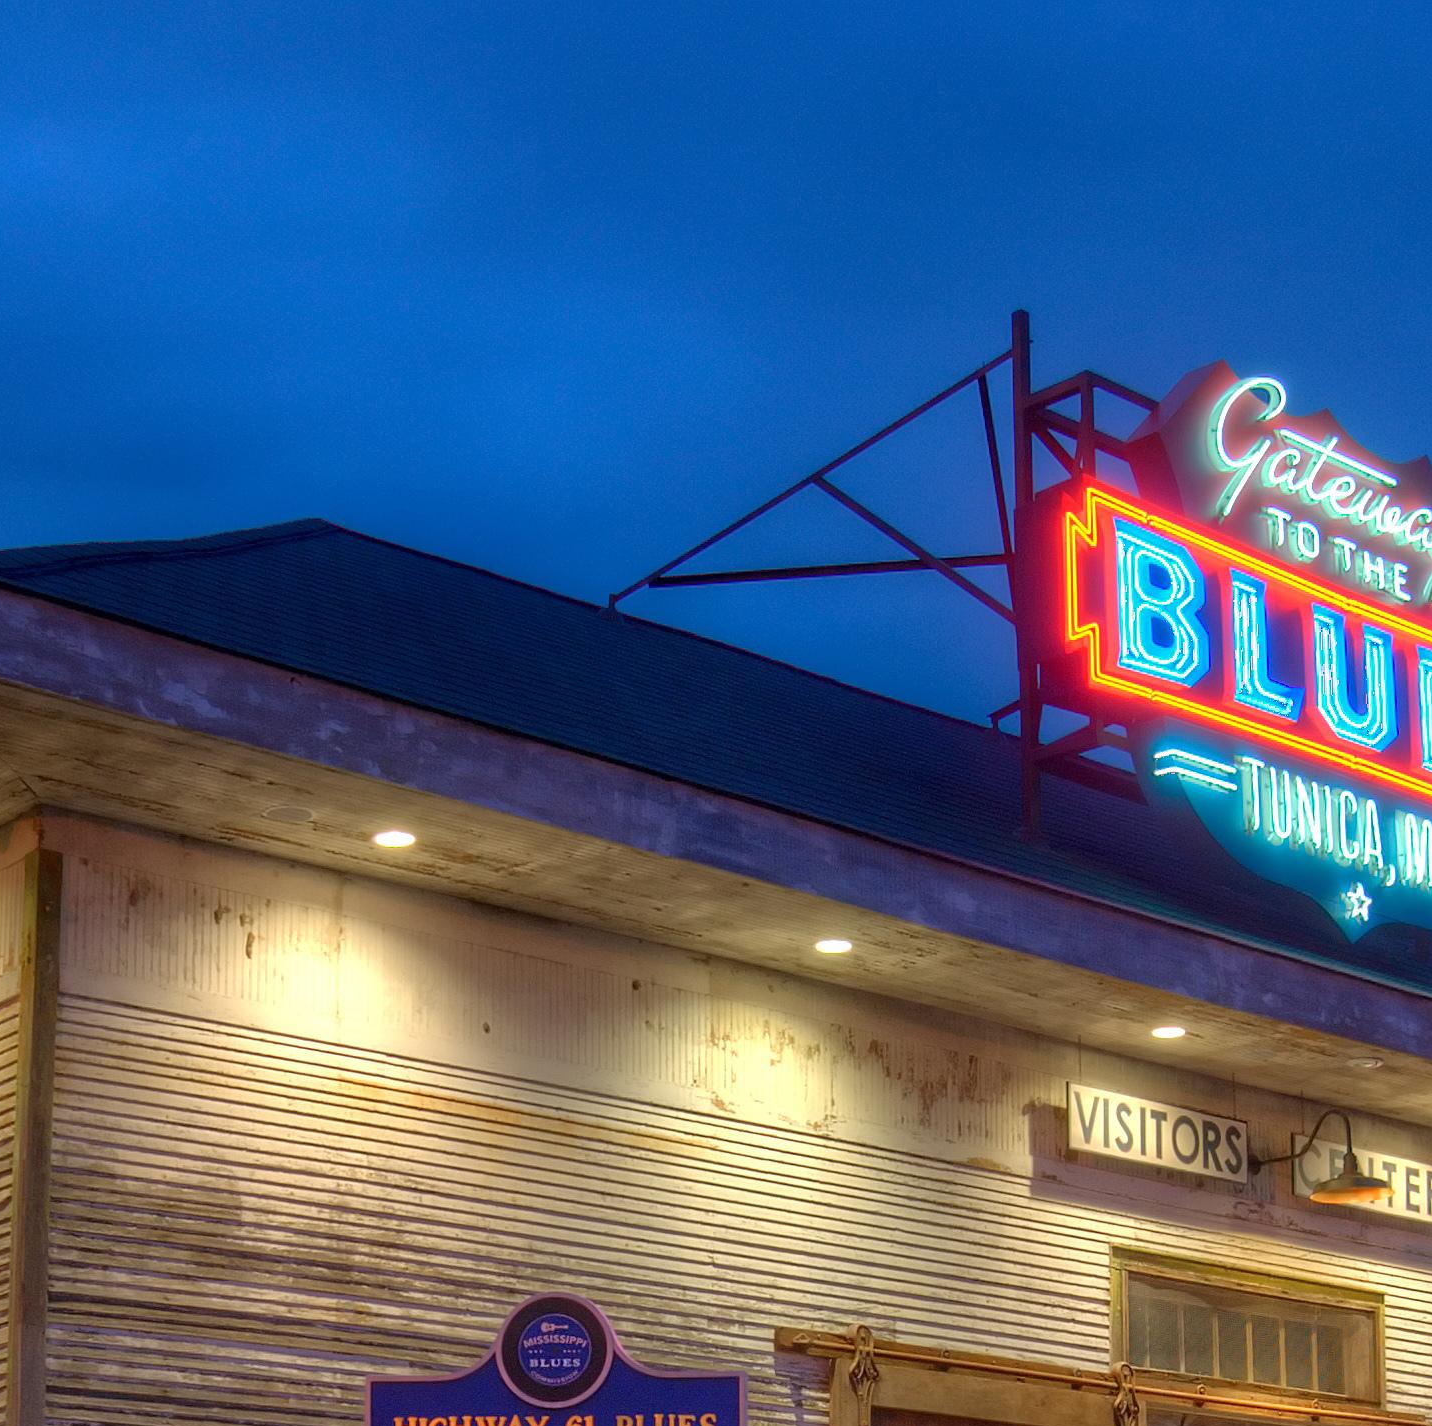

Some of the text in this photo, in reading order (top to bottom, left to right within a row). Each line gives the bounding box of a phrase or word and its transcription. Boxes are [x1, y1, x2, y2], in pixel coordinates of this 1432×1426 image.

[1265, 507, 1413, 603] TO THE
[1073, 1089, 1244, 1175] VISITORS
[522, 1334, 588, 1349] MISSISSIPPI
[529, 1358, 581, 1368] BLUES
